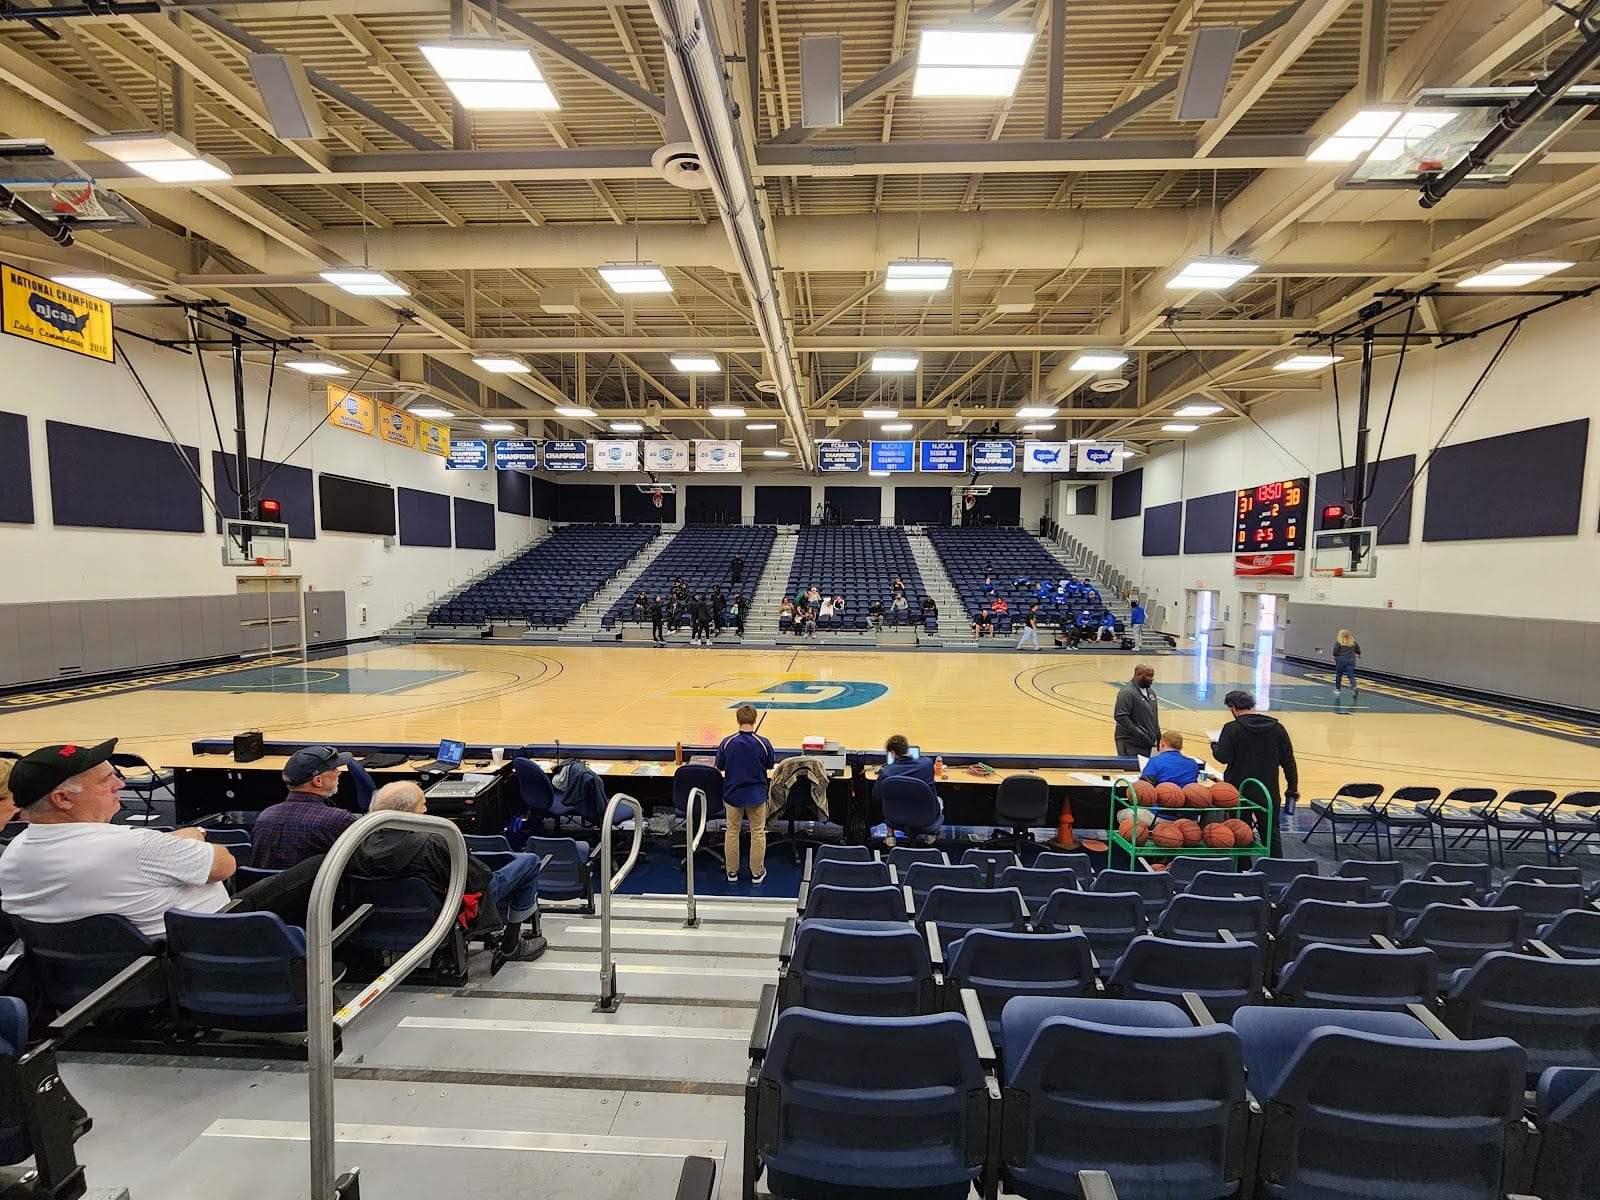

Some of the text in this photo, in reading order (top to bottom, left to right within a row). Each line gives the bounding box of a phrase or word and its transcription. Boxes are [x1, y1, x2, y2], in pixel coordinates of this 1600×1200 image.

[10, 273, 104, 314] NATIONAL CHAMPIONS
[36, 303, 76, 324] njcaa
[1258, 482, 1282, 501] 13:50
[1286, 488, 1300, 506] 38
[1240, 497, 1253, 513] 31
[1272, 504, 1280, 516] 2
[1239, 530, 1246, 542] 0
[1288, 526, 1296, 539] 0
[45, 1080, 53, 1092] E
